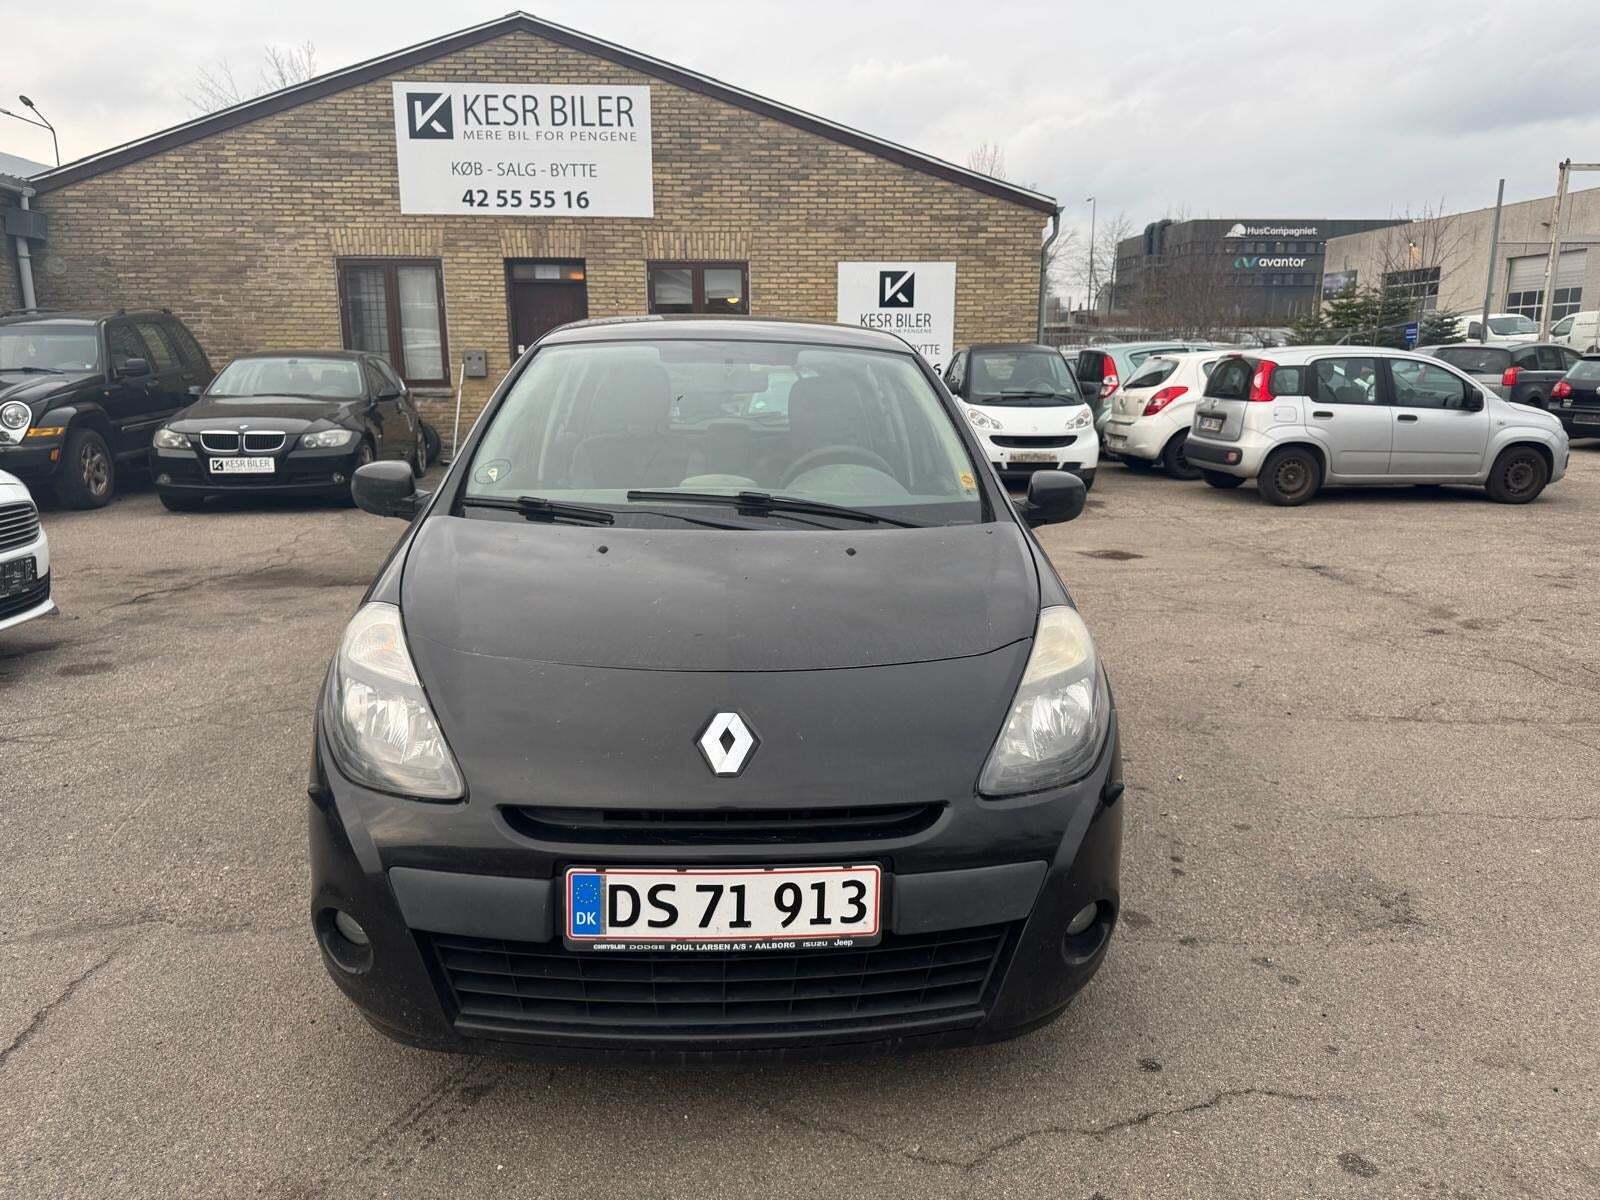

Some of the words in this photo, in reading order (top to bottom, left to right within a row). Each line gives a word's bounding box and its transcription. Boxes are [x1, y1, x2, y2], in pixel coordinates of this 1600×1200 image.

[463, 94, 540, 126] KESR
[551, 95, 634, 127] BILER
[463, 130, 502, 141] MERE
[508, 131, 530, 141] BIL
[536, 131, 564, 141] FOR
[570, 131, 637, 142] PENGENE
[451, 161, 483, 176] KØB
[496, 162, 536, 177] SALG
[550, 163, 597, 178] BYTTE
[462, 189, 488, 207] 42
[496, 190, 522, 208] 55
[529, 191, 555, 208] 55
[564, 191, 589, 208] 16
[1247, 226, 1318, 237] HusCompagniet
[1259, 257, 1306, 267] avantor
[860, 313, 892, 328] KESR
[896, 313, 932, 328] BILER
[225, 460, 246, 468] KESR
[247, 460, 270, 468] BILER
[608, 884, 679, 928] DS
[695, 884, 752, 928] 71
[773, 880, 867, 928] 913
[576, 911, 596, 925] DK
[833, 939, 853, 947] Jeep
